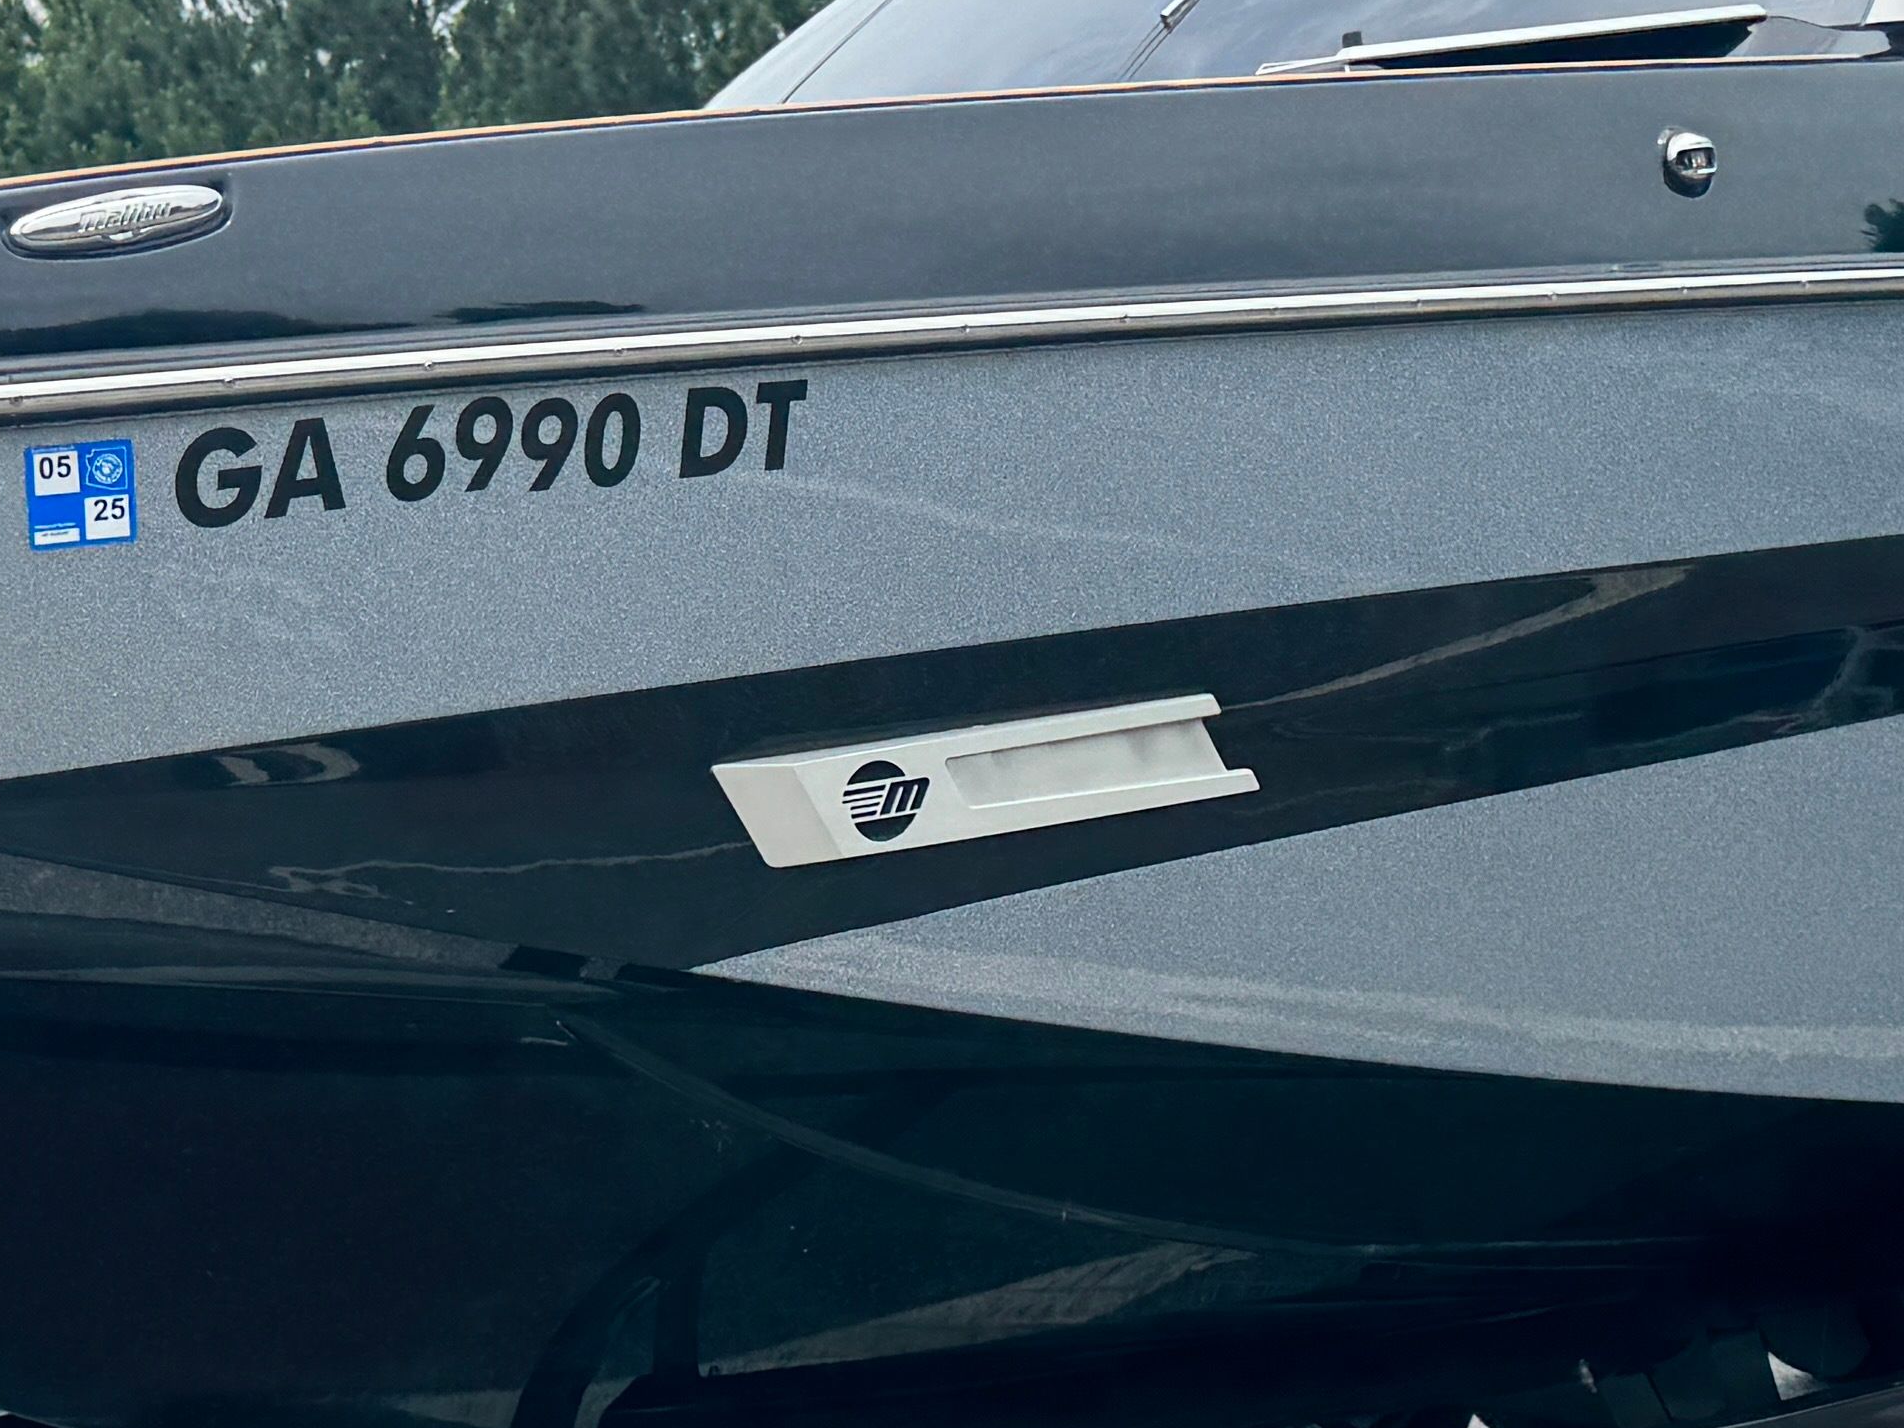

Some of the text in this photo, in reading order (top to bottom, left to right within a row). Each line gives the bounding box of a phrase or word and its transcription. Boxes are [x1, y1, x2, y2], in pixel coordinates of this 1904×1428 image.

[174, 378, 810, 529] GA 6990 DT
[39, 455, 72, 480] 05
[93, 497, 125, 522] 25
